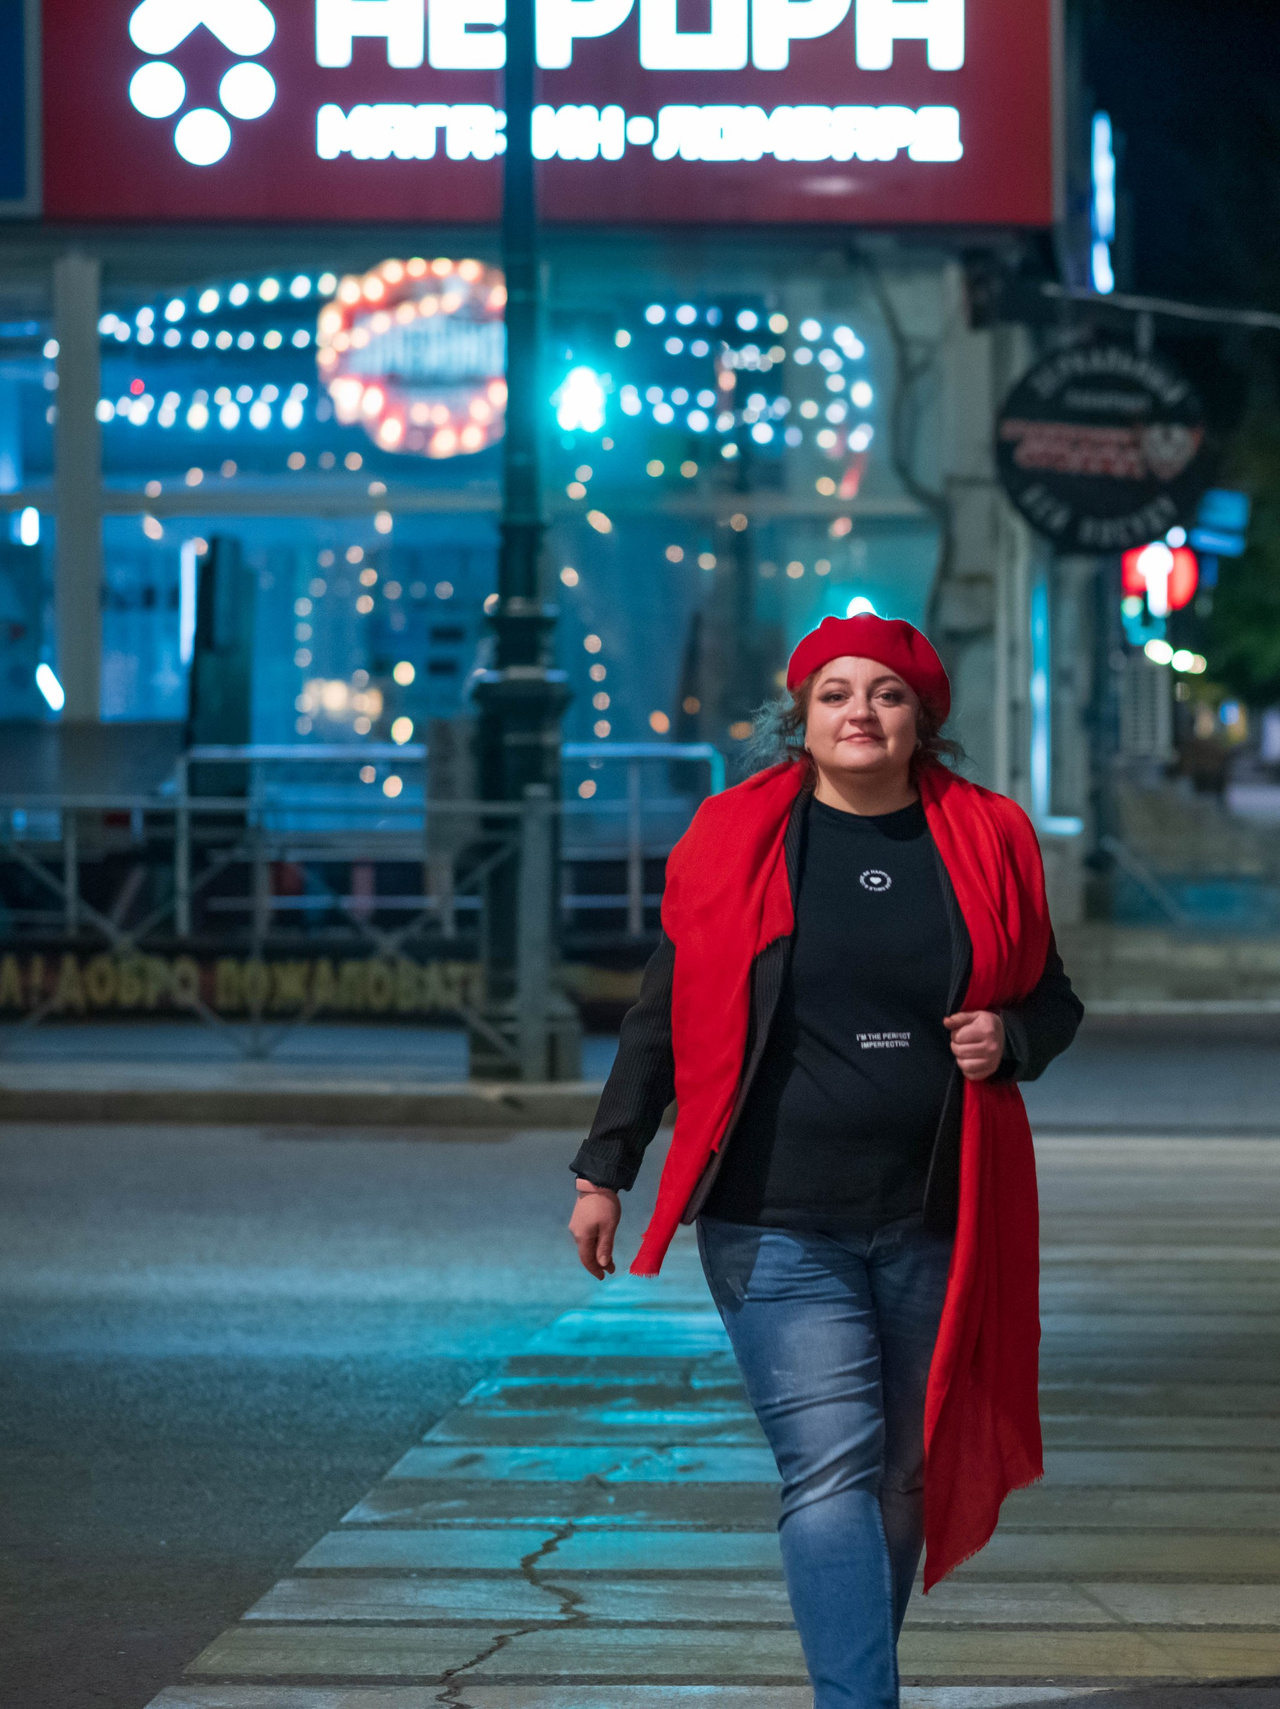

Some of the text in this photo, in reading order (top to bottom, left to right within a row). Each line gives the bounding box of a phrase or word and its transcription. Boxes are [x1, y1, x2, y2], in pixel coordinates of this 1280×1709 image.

[316, 103, 626, 161] МАГАИН
[856, 1033, 867, 1041] I'M
[867, 1032, 881, 1040] THE
